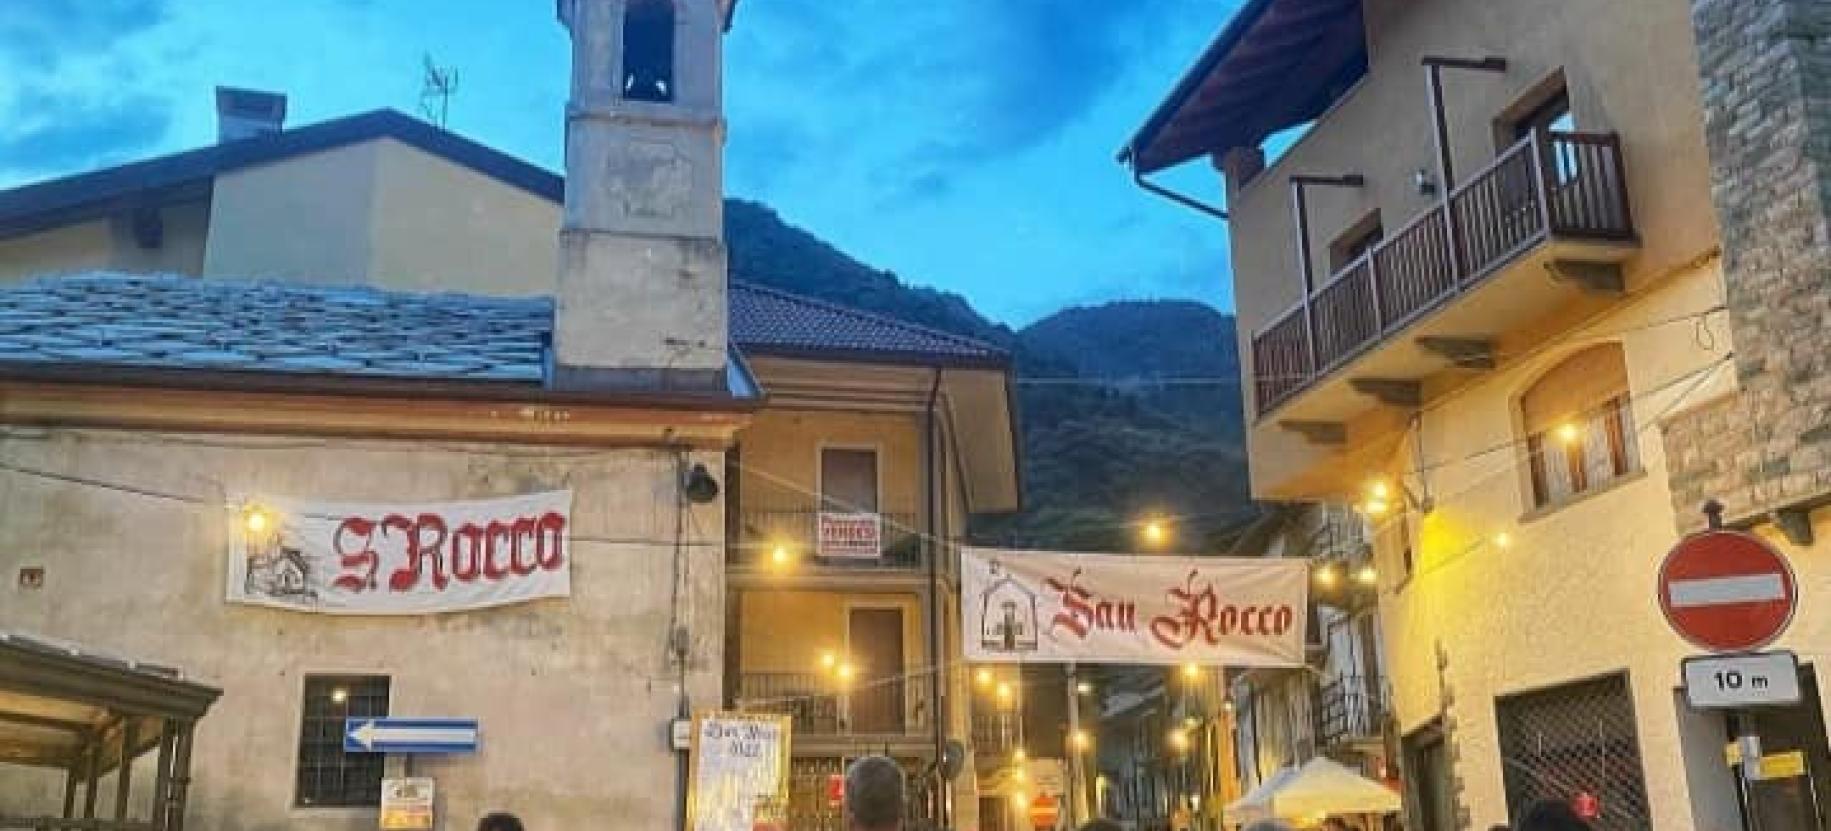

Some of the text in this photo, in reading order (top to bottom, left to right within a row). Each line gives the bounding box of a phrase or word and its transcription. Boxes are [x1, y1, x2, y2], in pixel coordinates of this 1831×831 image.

[382, 511, 566, 592] Rocco
[1043, 567, 1293, 650] San Rocco
[1713, 671, 1768, 691] 10 m
